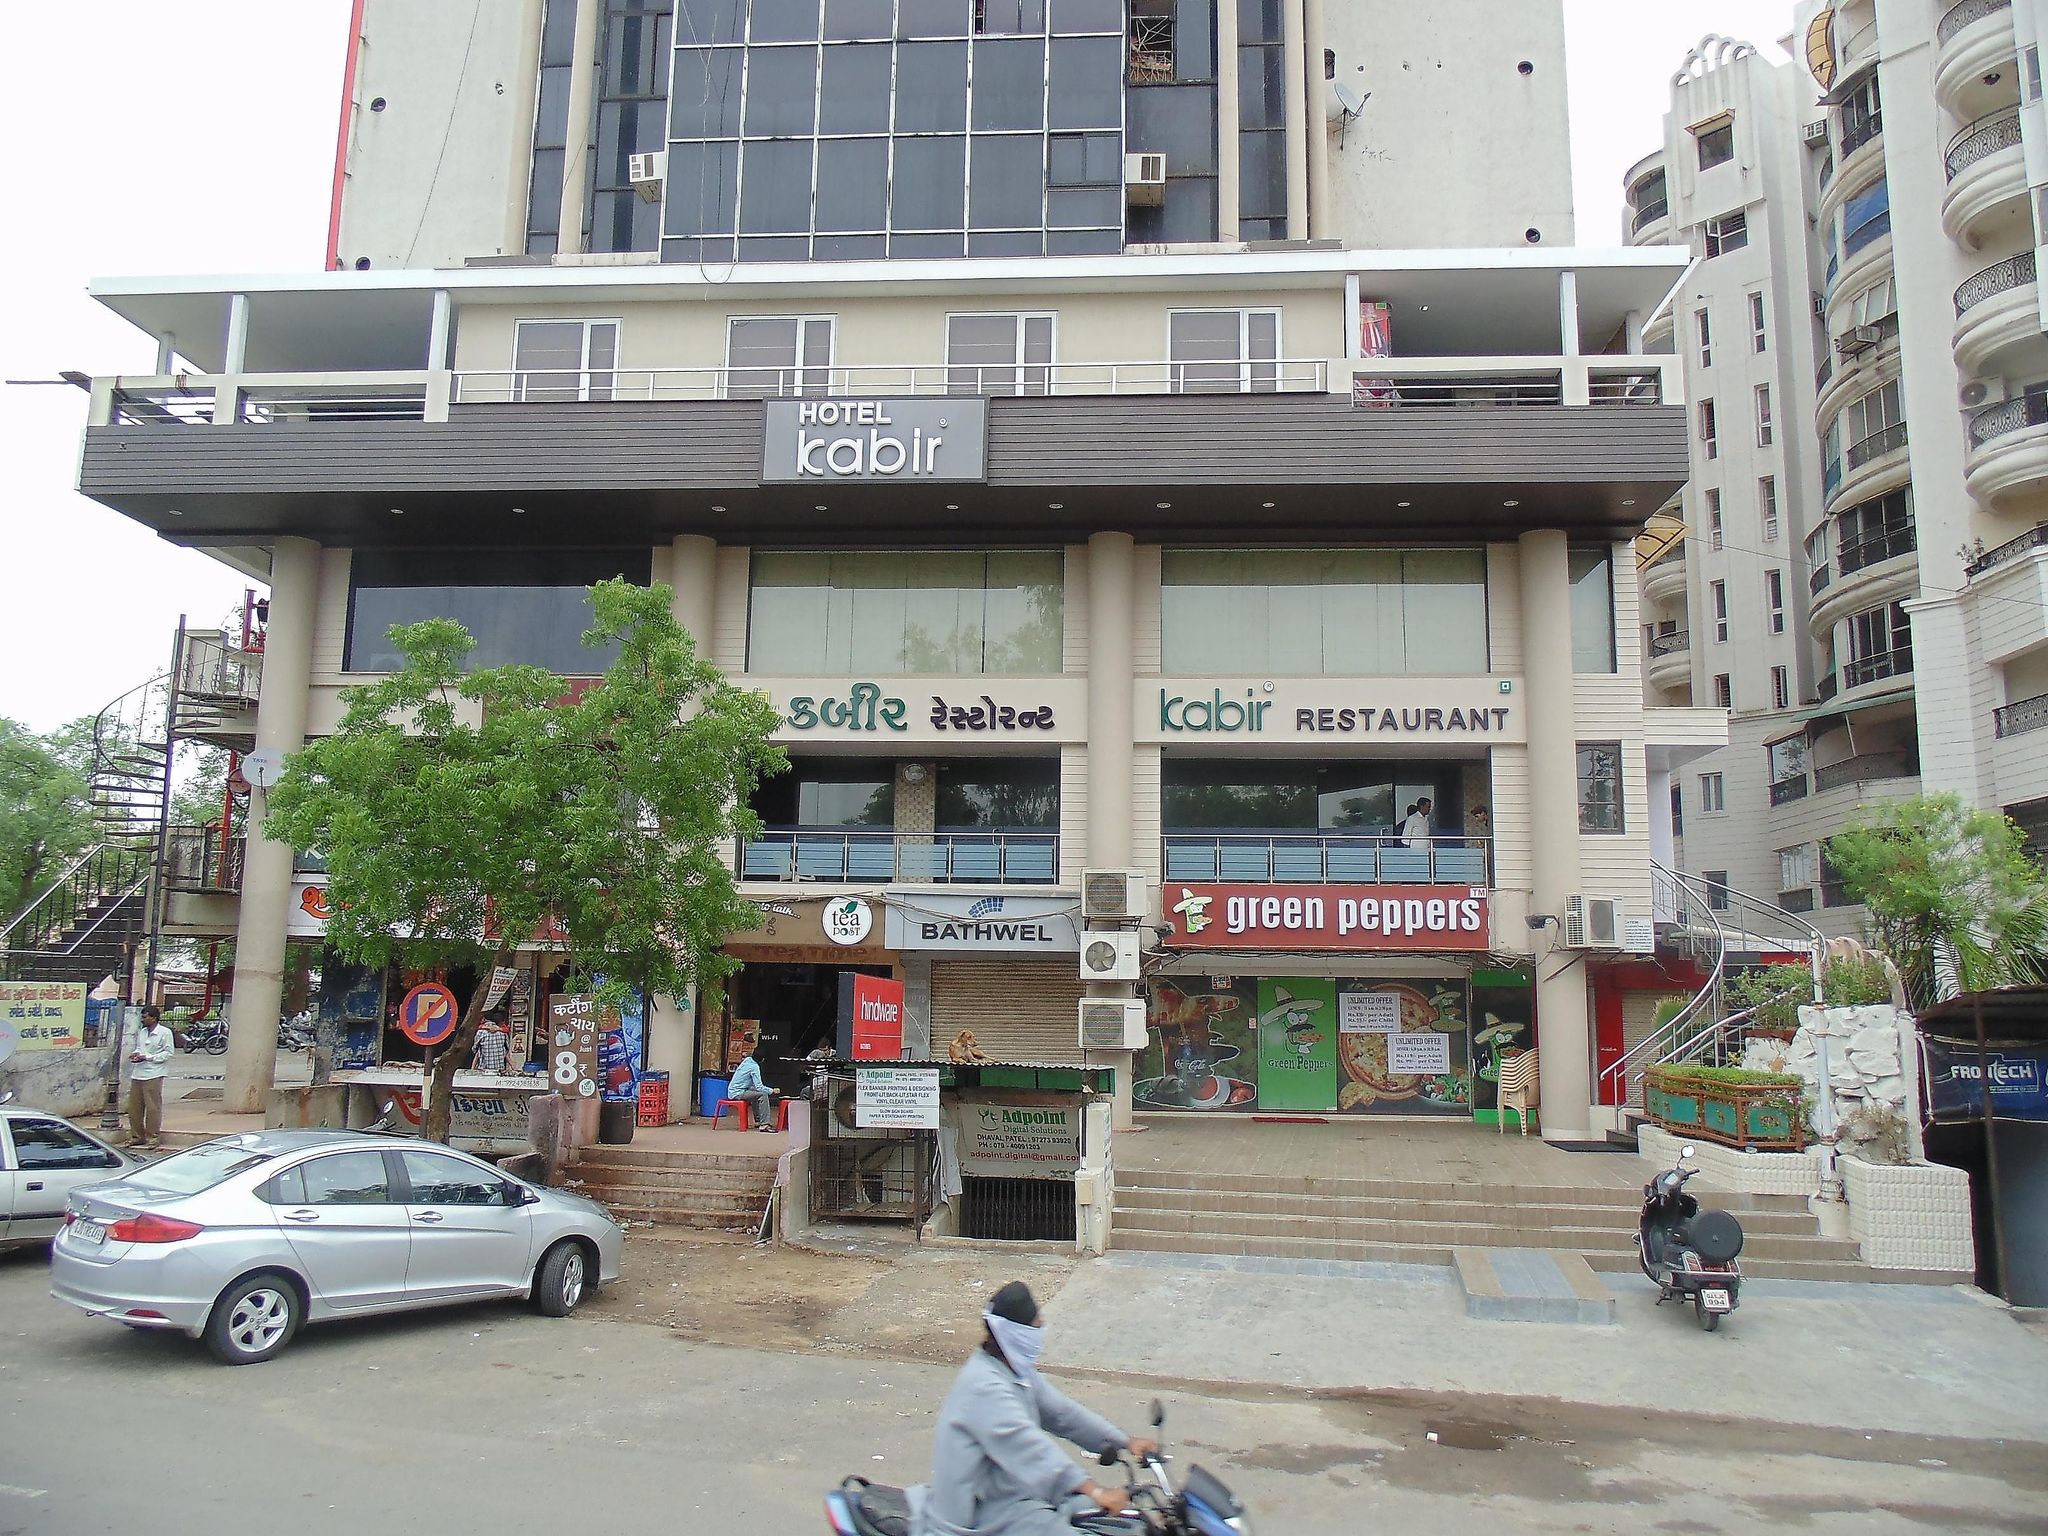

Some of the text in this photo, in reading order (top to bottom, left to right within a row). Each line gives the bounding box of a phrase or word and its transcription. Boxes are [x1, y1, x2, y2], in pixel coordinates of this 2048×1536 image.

[799, 401, 892, 426] HOTEL
[796, 427, 943, 476] kabir
[786, 682, 908, 731] કબીર
[1160, 688, 1509, 732] kabir RESTAURANT
[832, 910, 860, 926] tea
[1226, 896, 1480, 936] green peppers
[921, 923, 1053, 942] BATHWEL
[861, 992, 898, 1022] hindware
[1375, 997, 1393, 1005] OFFER
[417, 993, 447, 1033] P
[570, 1017, 596, 1033] चाय
[1424, 1037, 1441, 1045] OFFER
[554, 1051, 578, 1085] 8
[1268, 1059, 1295, 1070] Green
[866, 1071, 893, 1079] Adpoint
[1002, 1109, 1067, 1125] Adpoint
[977, 1133, 1004, 1141] DHAVAL
[1003, 1125, 1067, 1135] Digital Solutions
